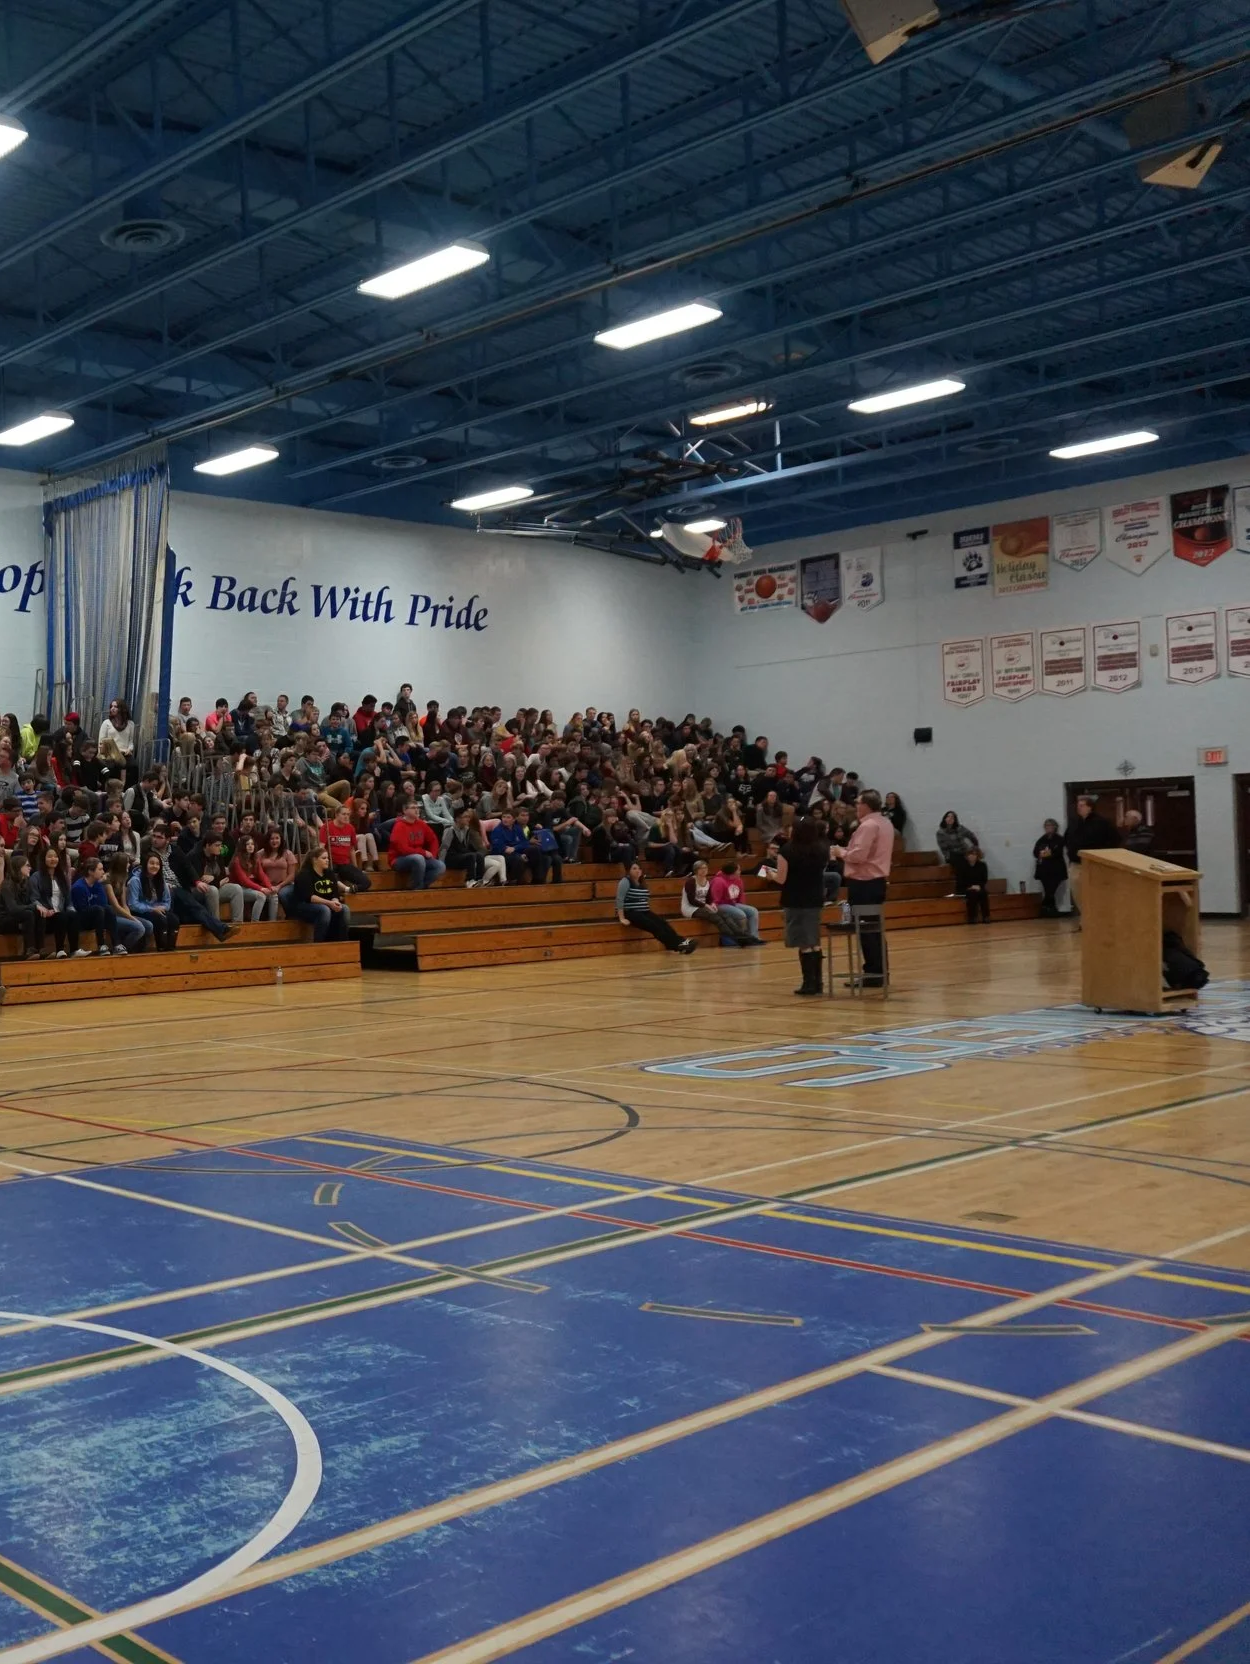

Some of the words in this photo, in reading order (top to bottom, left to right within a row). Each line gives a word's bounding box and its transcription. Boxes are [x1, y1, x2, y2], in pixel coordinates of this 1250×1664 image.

[996, 560, 1036, 574] Holiday
[206, 575, 300, 616] Back
[310, 584, 395, 624] With
[405, 594, 488, 632] Pride
[1183, 666, 1204, 675] 2012
[1108, 674, 1128, 682] 2012
[1056, 679, 1074, 687] 2011
